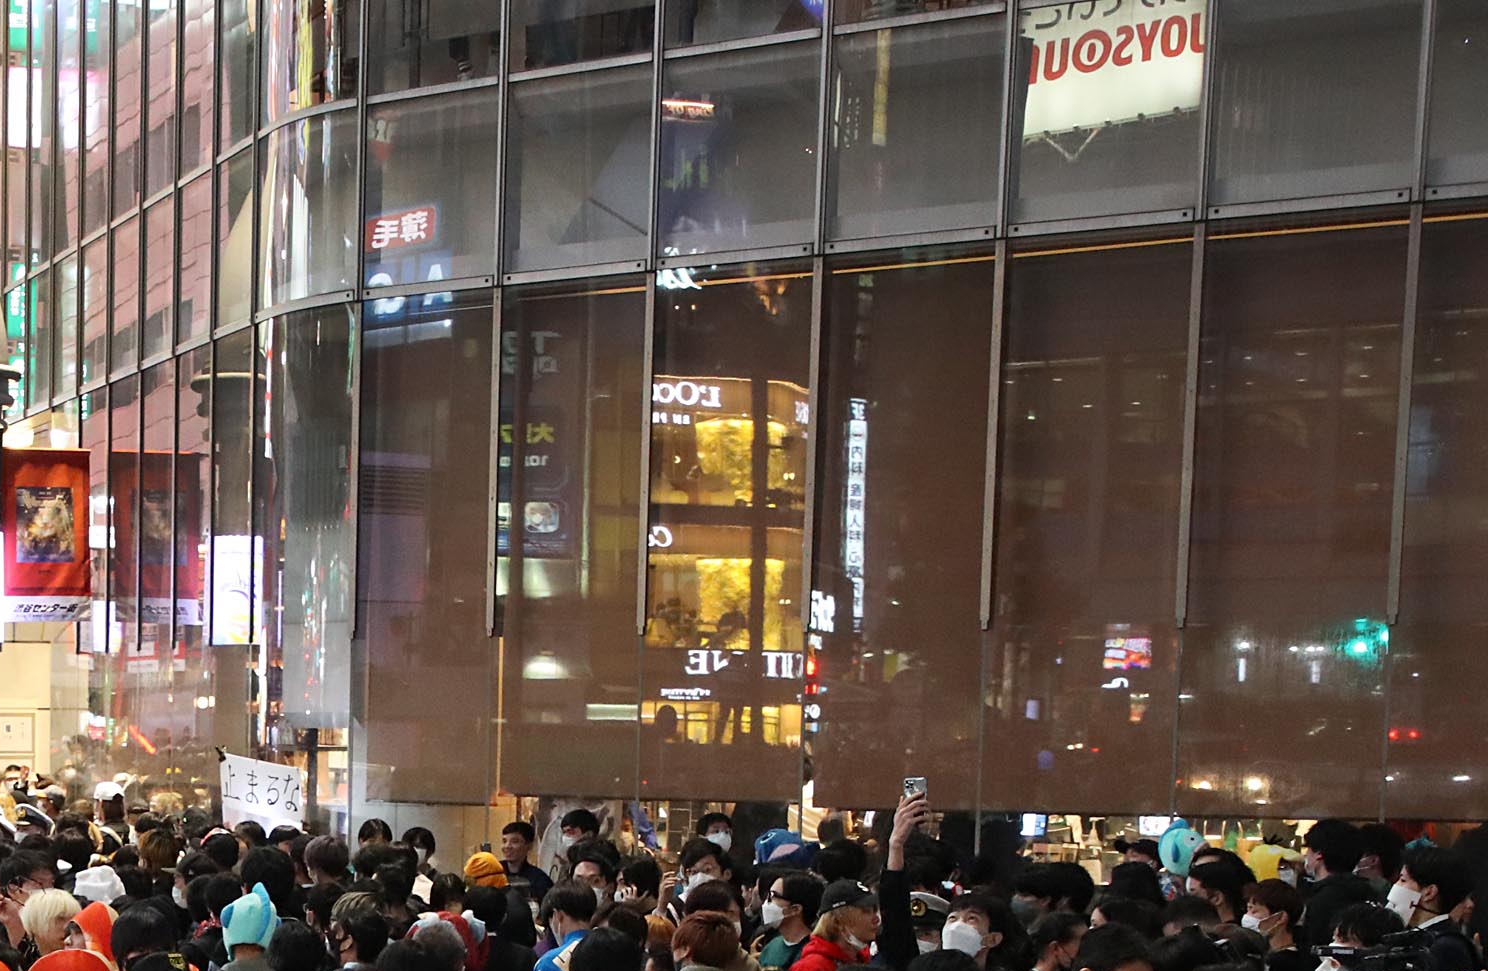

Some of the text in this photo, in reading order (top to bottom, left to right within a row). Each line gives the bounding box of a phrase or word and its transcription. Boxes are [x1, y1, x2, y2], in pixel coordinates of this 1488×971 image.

[14, 603, 78, 613] 渋谷センター街
[223, 764, 300, 812] 止まるな
